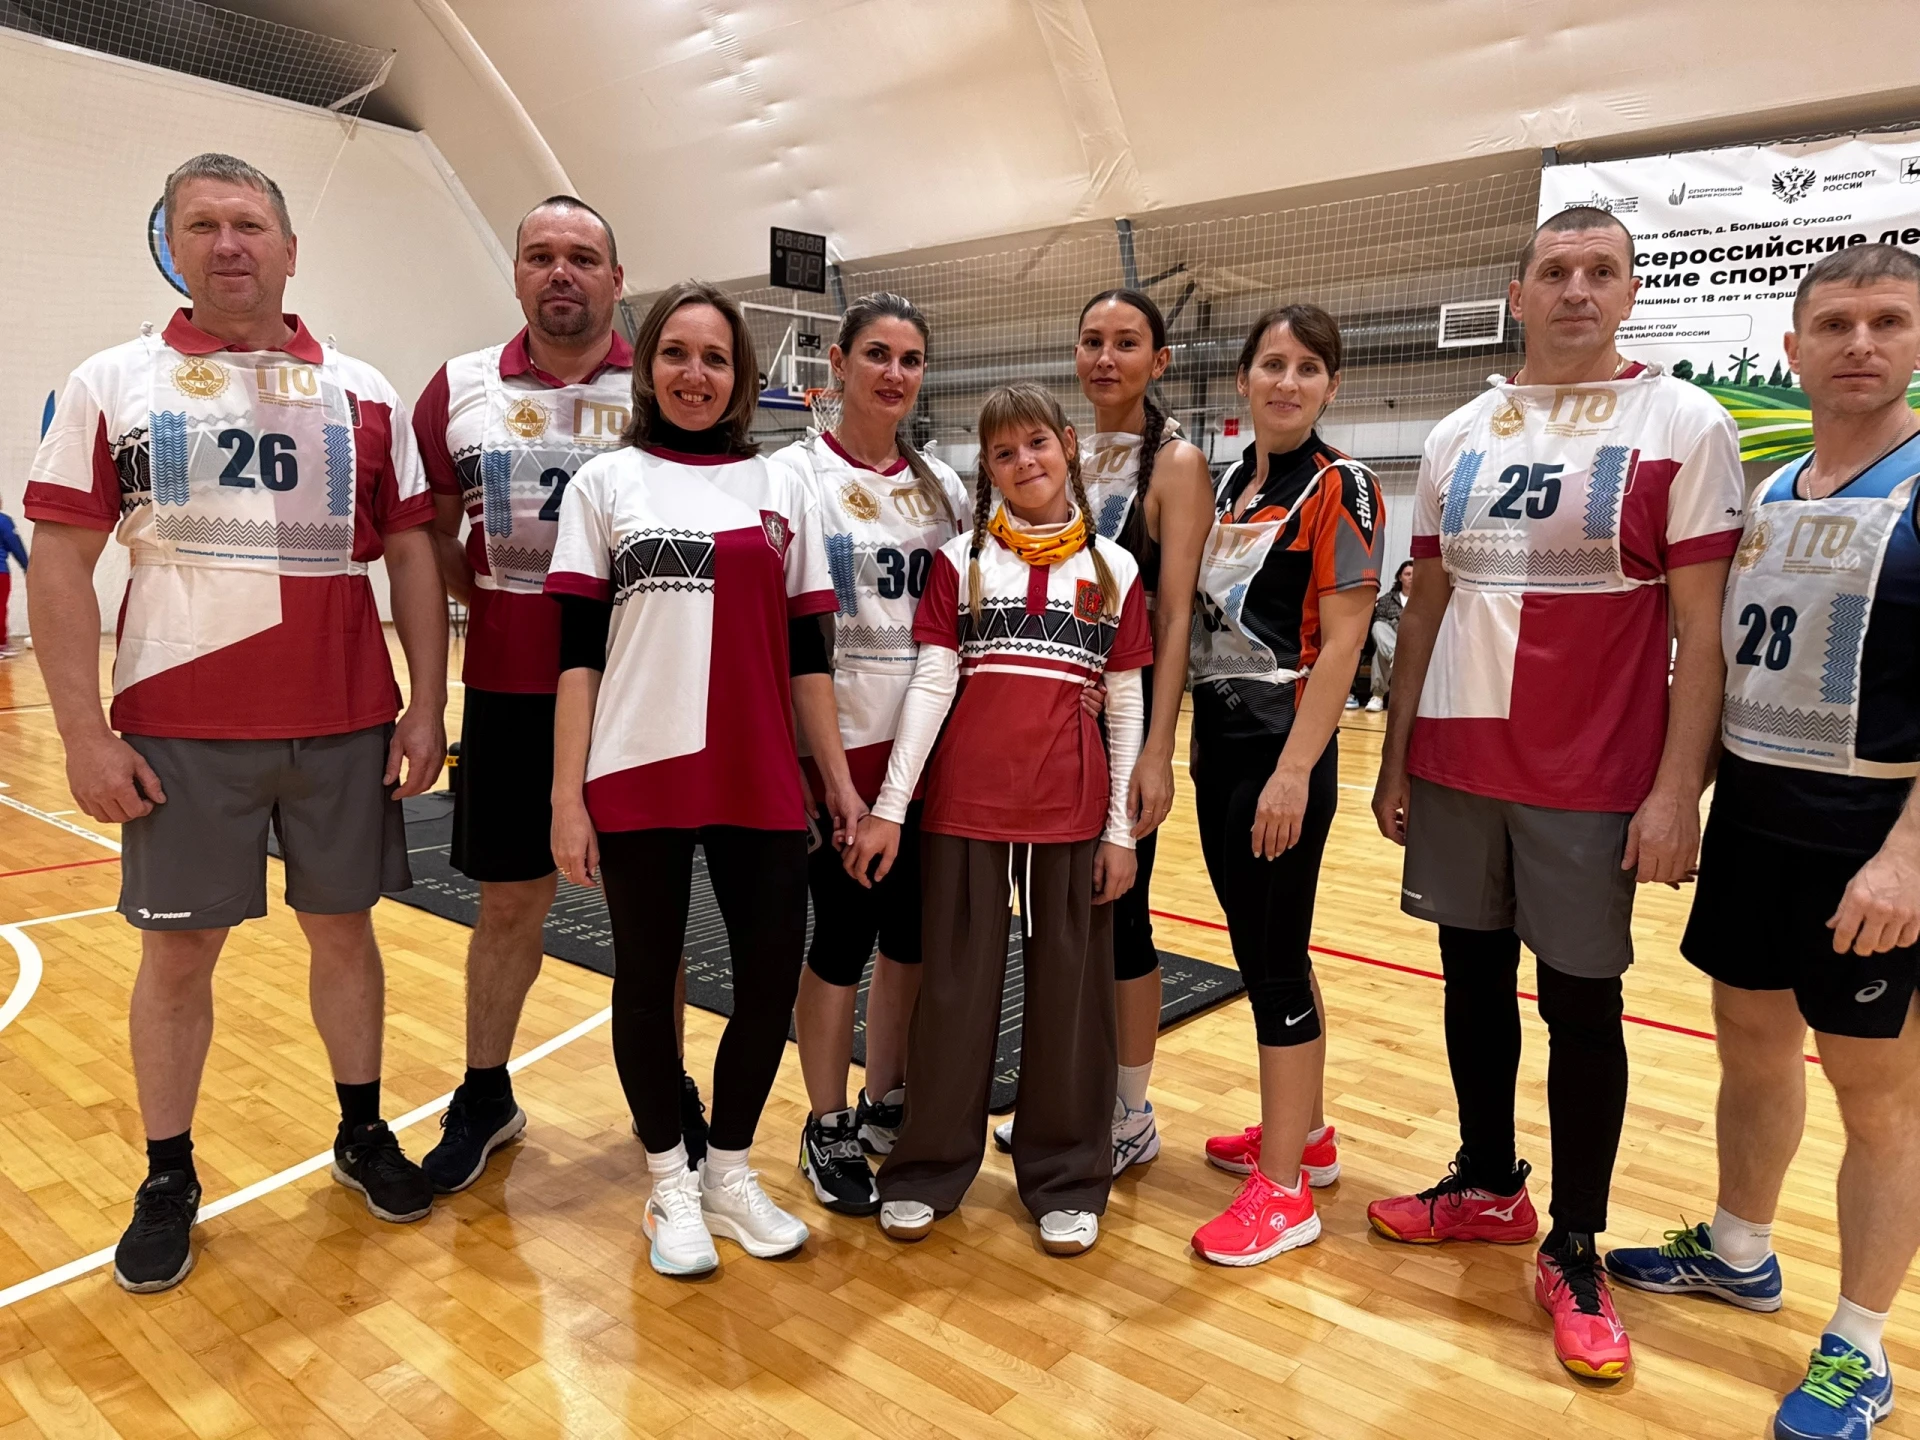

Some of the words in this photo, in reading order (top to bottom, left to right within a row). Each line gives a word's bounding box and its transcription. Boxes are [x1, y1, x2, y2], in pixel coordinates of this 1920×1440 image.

[1688, 185, 1743, 194] СПОРТИВНЫЙ
[1823, 181, 1863, 192] РОССИИ
[1824, 169, 1877, 183] МИНСПОРТ
[1662, 227, 1712, 239] область,
[1715, 226, 1726, 234] д.
[1730, 218, 1789, 232] Большой
[1793, 214, 1852, 226] Суходол
[1634, 233, 1867, 270] сероссийские
[1878, 227, 1920, 246] ле
[1710, 263, 1814, 286] спорт
[1634, 296, 1680, 305] нщины
[1684, 296, 1698, 304] от
[1701, 294, 1715, 302] 18
[1755, 290, 1797, 301] старш
[1635, 331, 1674, 339] НАРОДОВ
[573, 398, 631, 436] ГТО
[1548, 388, 1618, 423] ГТО
[217, 428, 299, 492] 26
[538, 467, 578, 522] 2
[1488, 462, 1565, 520] 25
[1786, 515, 1857, 559] ГТО
[876, 547, 933, 600] 30
[1736, 602, 1798, 671] 28
[1213, 679, 1241, 711] IFE
[152, 911, 192, 920] proteam
